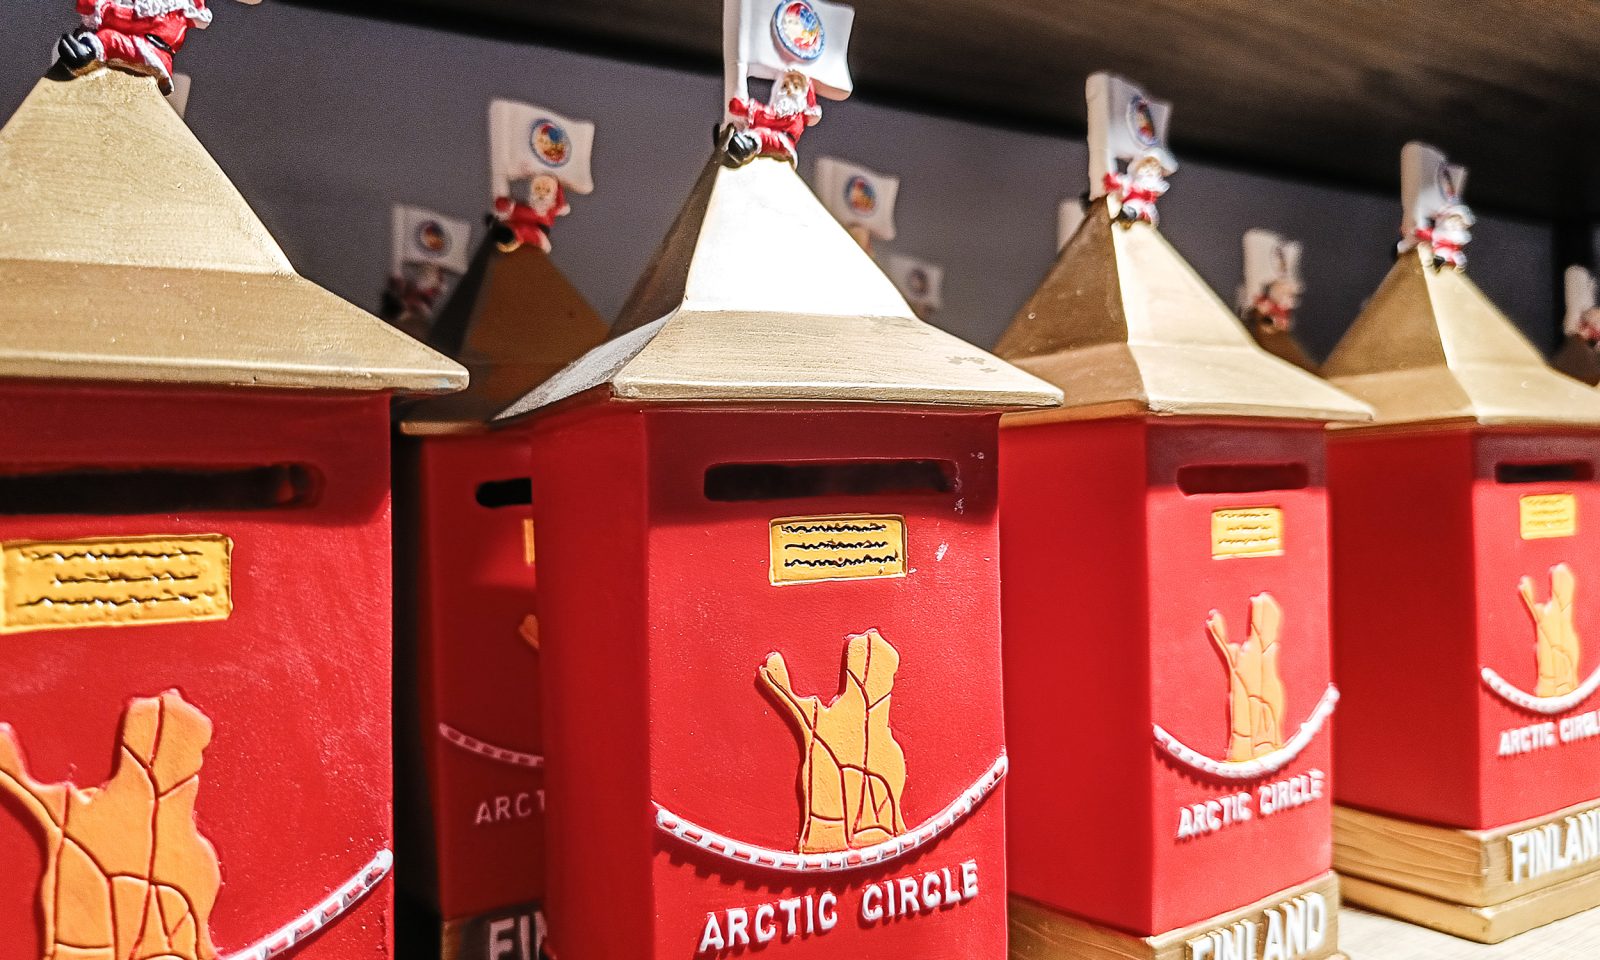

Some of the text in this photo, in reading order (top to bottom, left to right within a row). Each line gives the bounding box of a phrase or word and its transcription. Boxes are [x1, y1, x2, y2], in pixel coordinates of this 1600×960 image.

[1499, 709, 1600, 757] ARCTIC CIRCL
[1176, 768, 1325, 839] ARCTIC CIRCLE
[1509, 809, 1600, 884] FINLAN
[699, 858, 979, 953] ARCTIC CIRCLE
